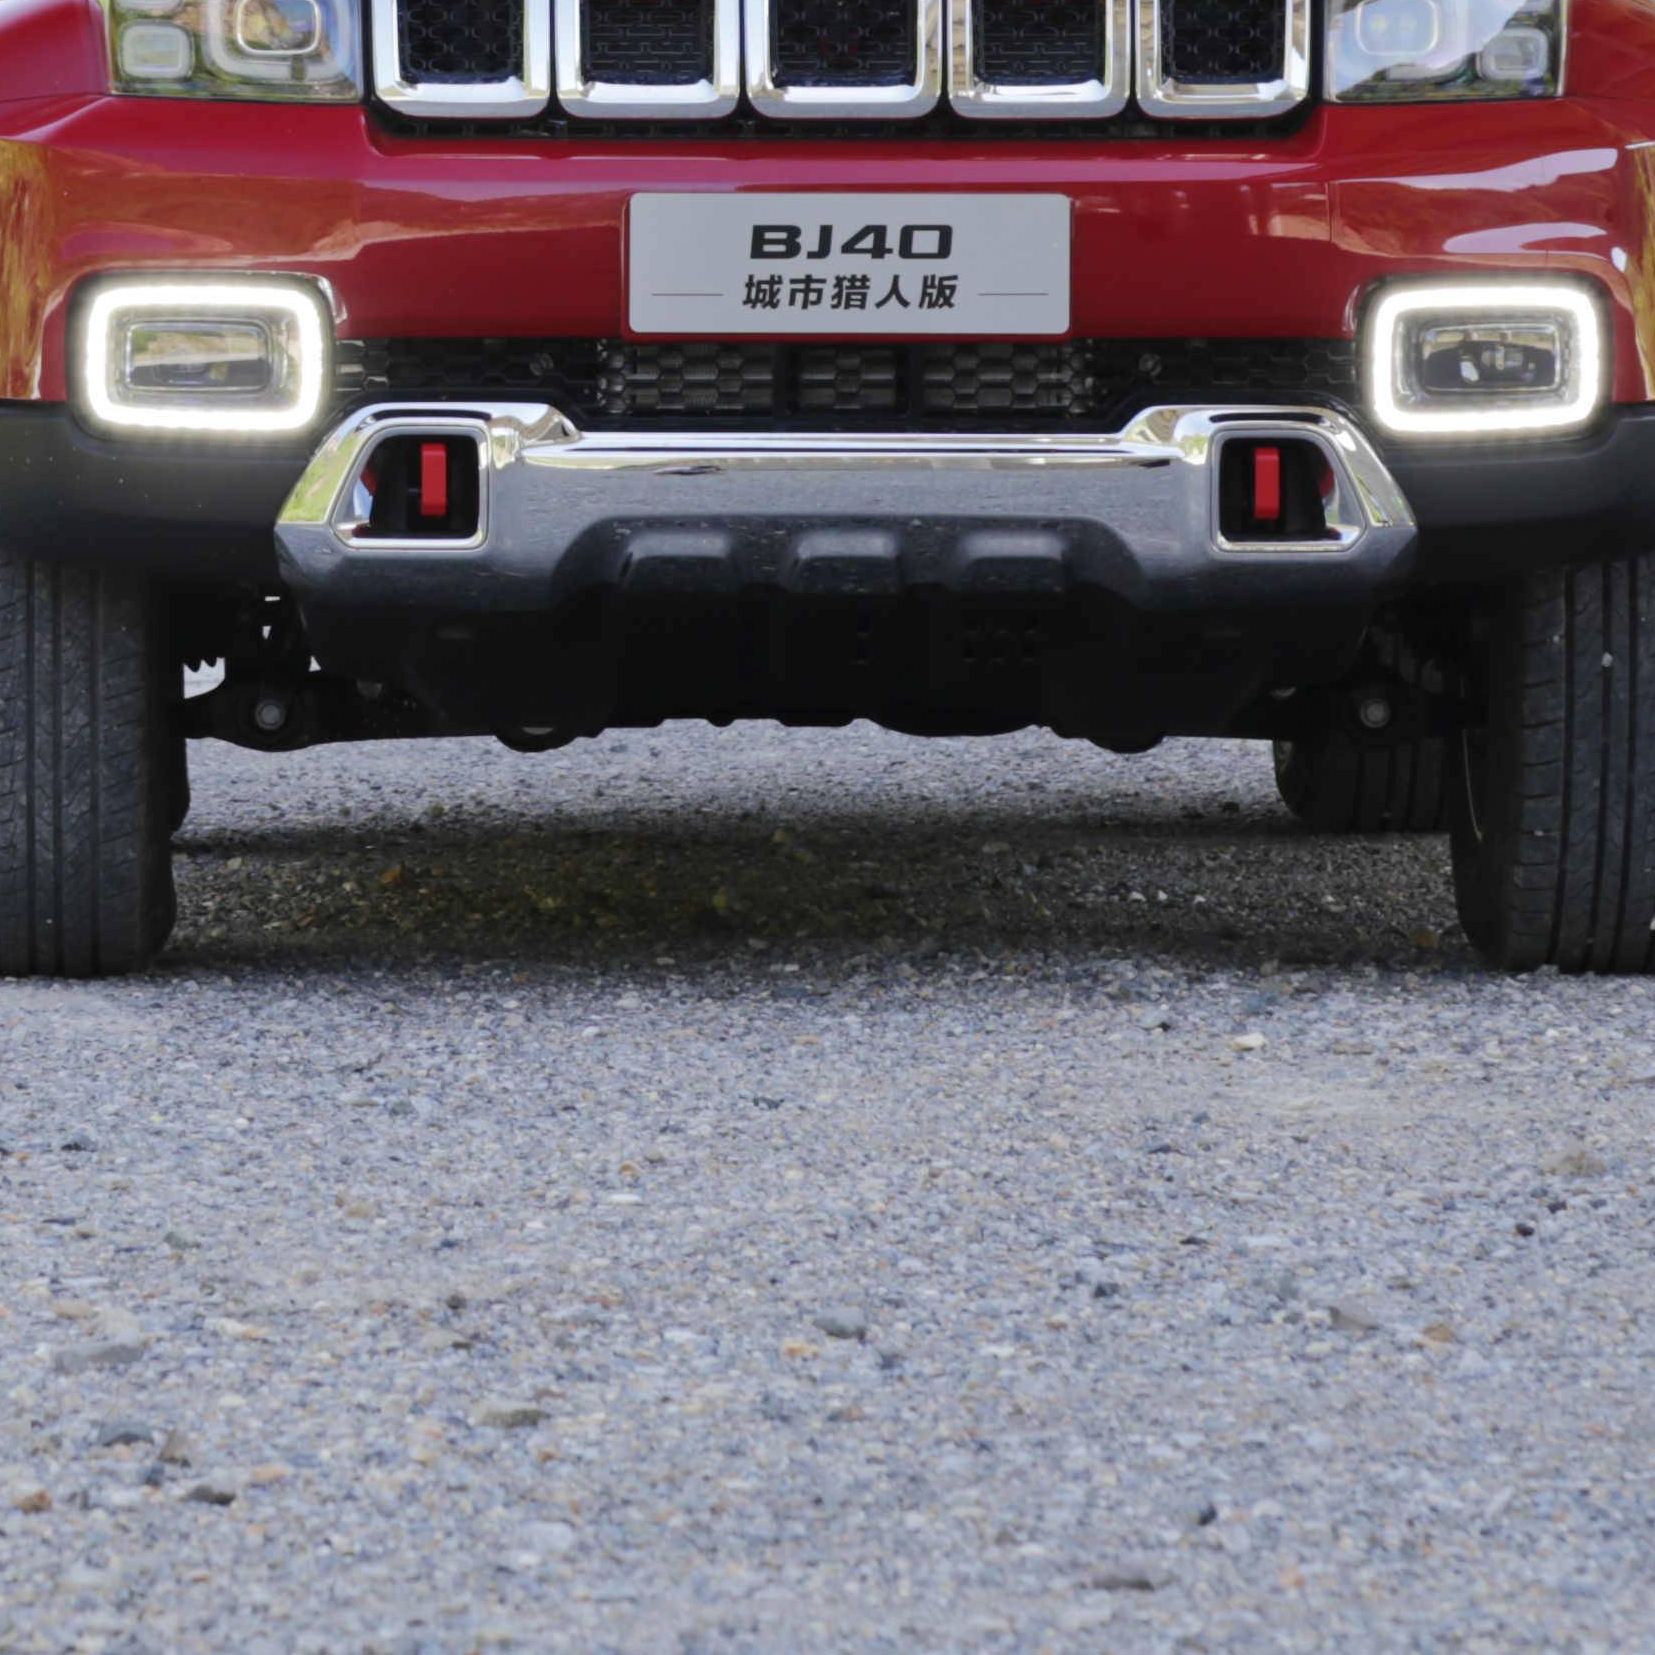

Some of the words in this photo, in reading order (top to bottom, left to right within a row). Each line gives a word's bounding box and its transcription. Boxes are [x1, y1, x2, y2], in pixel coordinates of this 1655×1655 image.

[749, 224, 953, 259] BJ40
[742, 274, 959, 311] 城市猎人版
